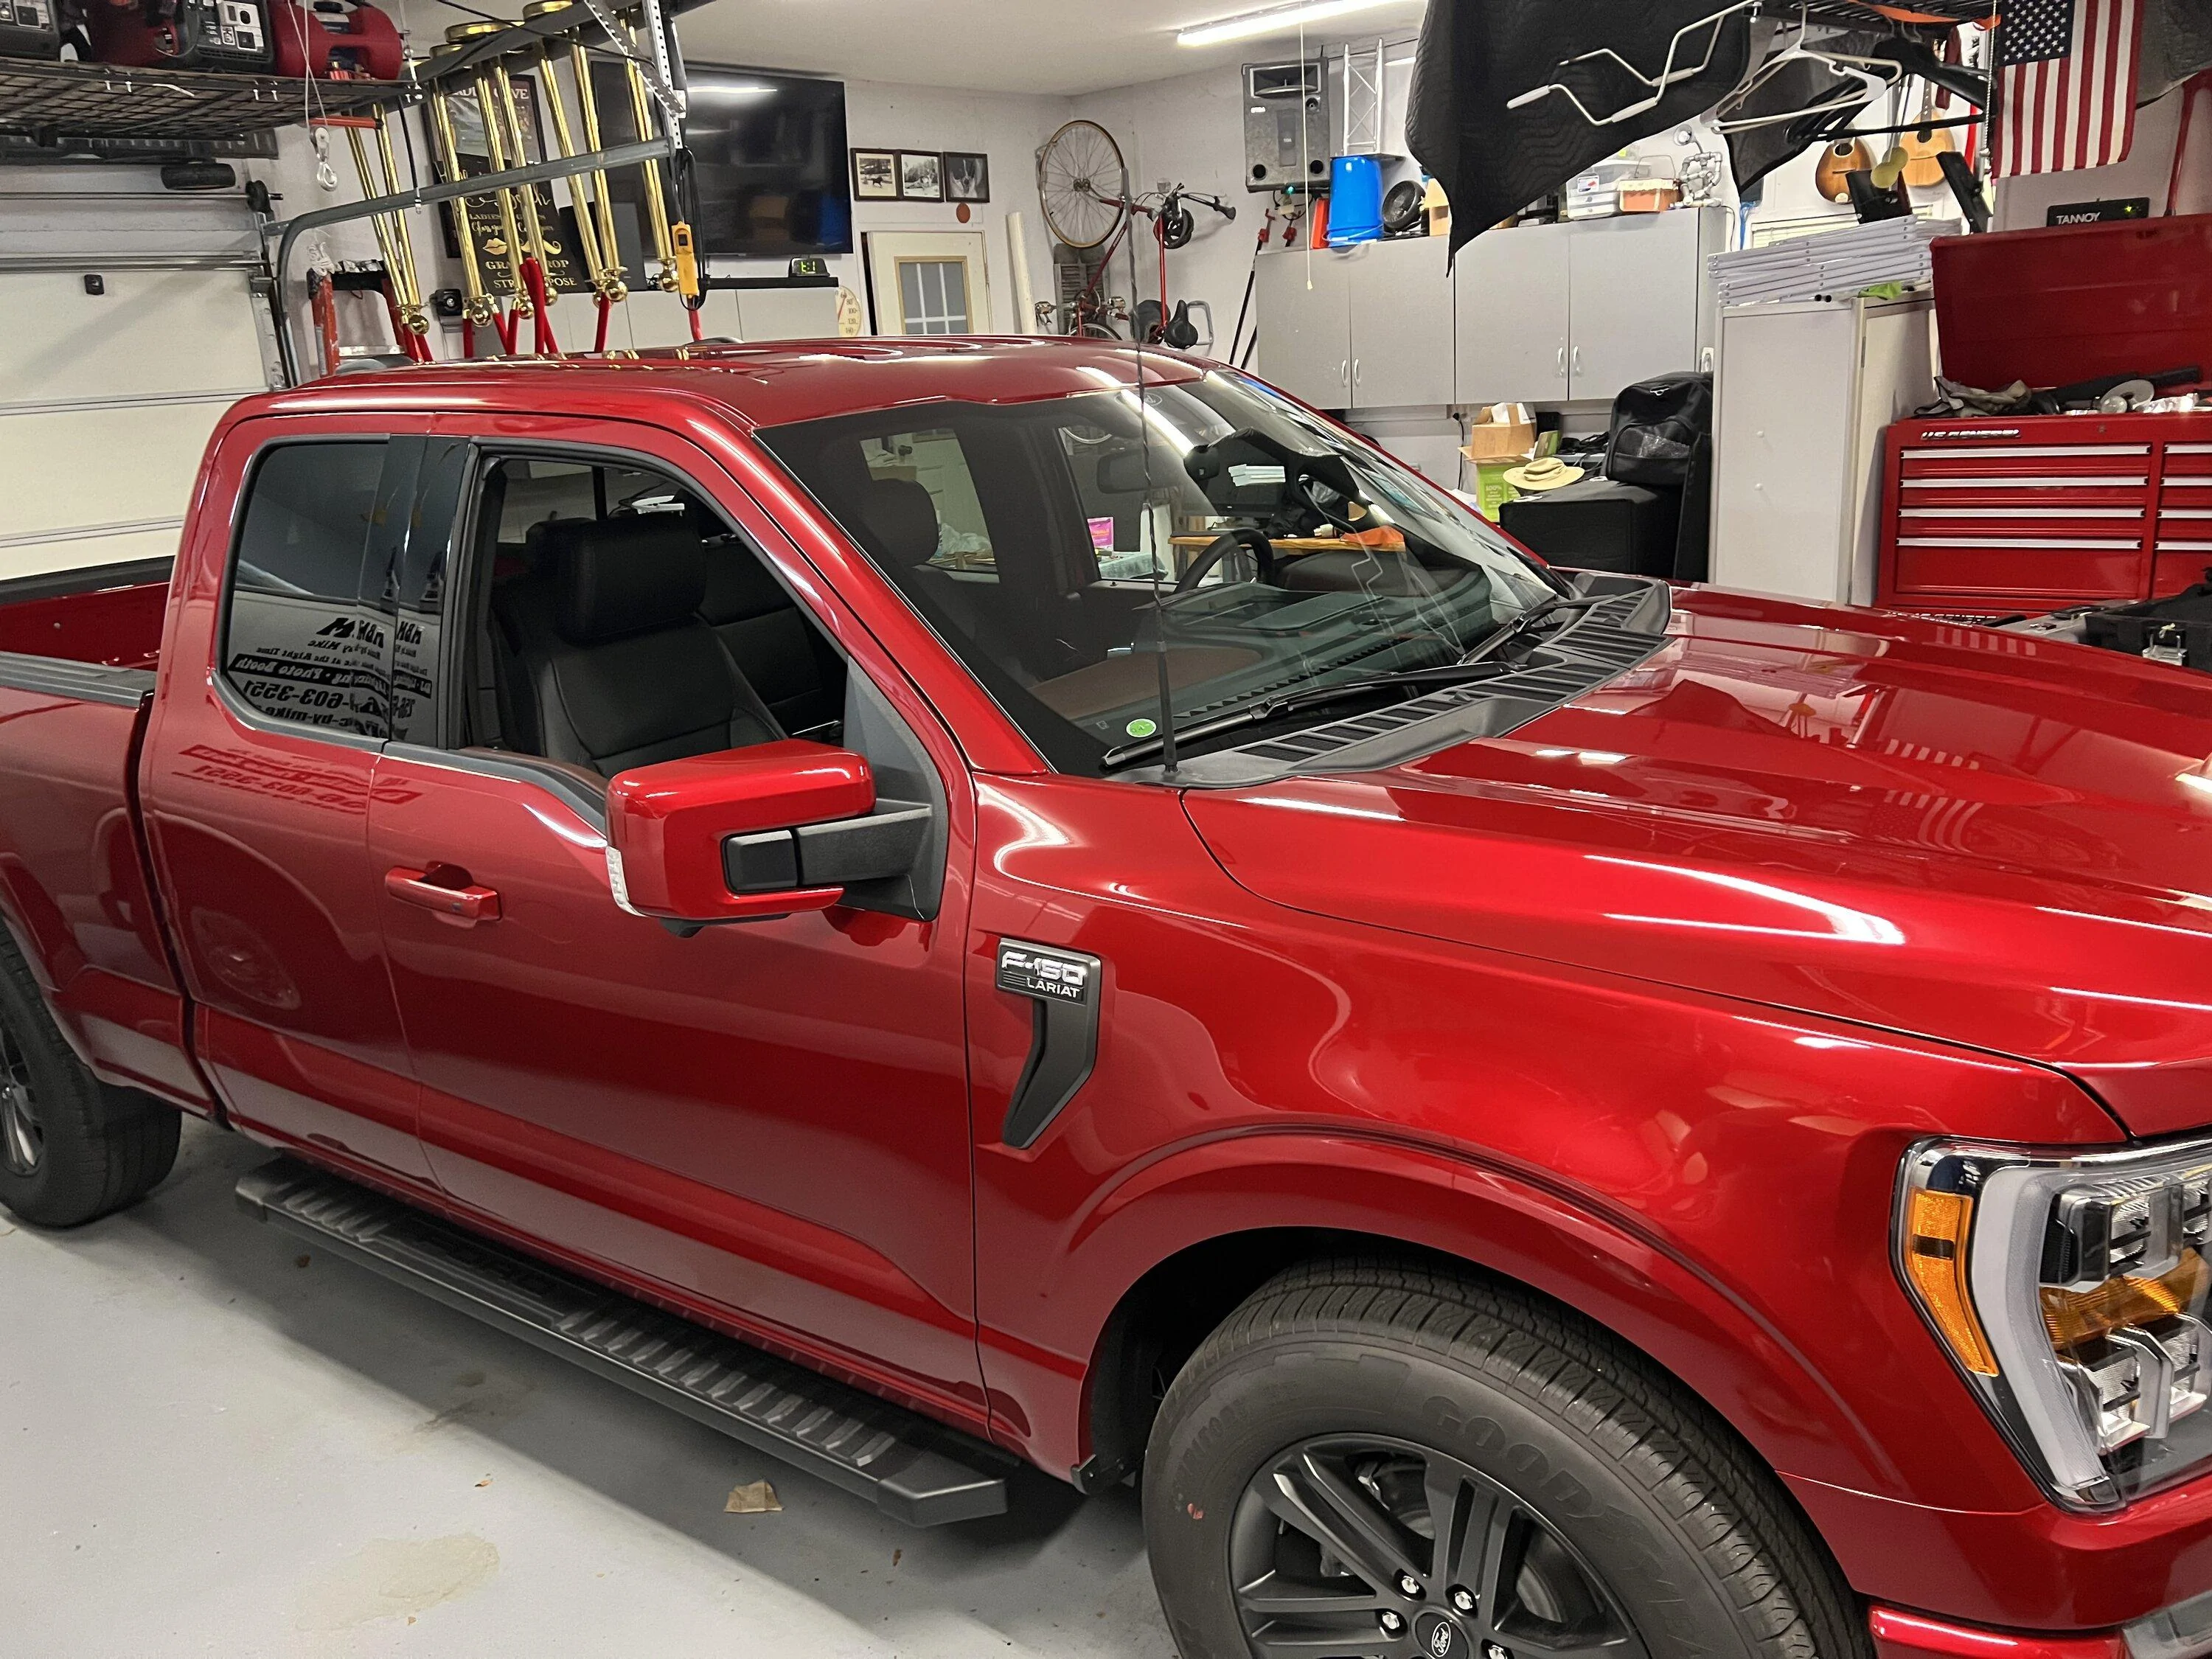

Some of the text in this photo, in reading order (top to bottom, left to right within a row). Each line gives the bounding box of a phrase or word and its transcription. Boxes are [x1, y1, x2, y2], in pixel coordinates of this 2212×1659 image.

[2056, 212, 2101, 225] TANNOY
[1001, 950, 1088, 986] F-150
[1026, 977, 1080, 998] LARIAT
